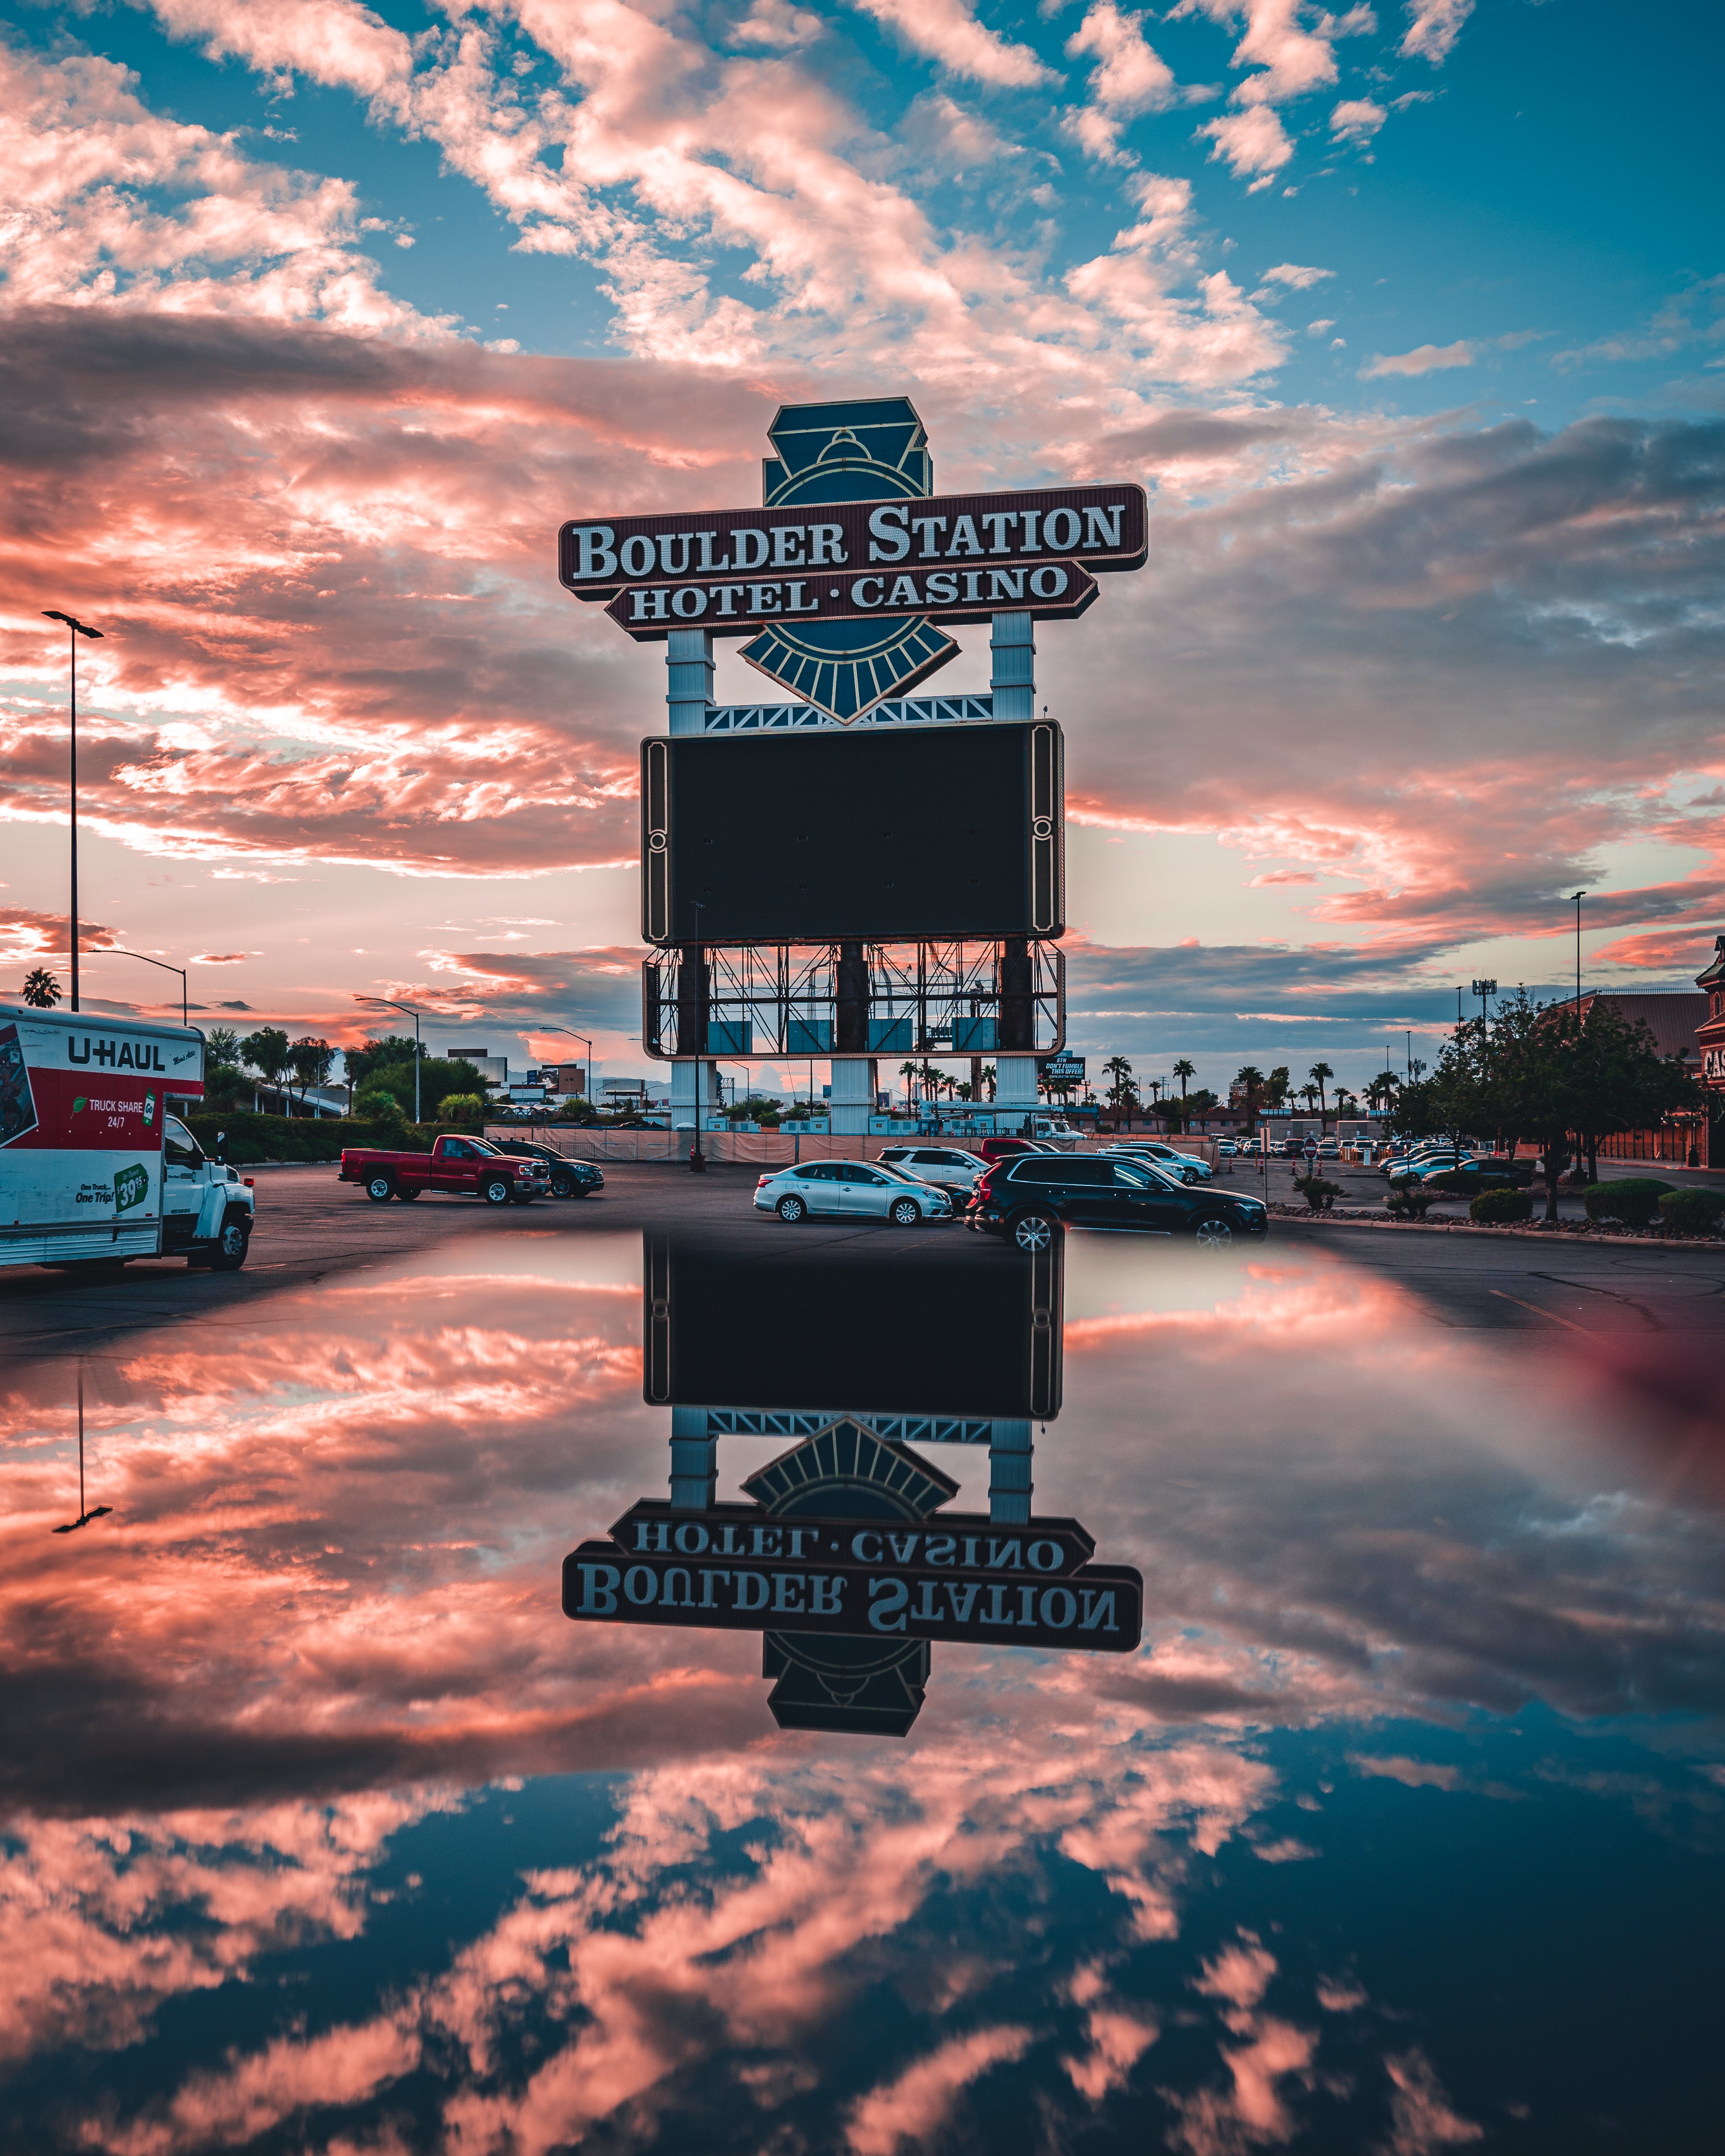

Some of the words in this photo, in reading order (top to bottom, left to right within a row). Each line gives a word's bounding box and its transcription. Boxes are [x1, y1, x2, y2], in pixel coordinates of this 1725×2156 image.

[573, 523, 849, 580] BOULDER
[868, 505, 1126, 562] STATION
[629, 582, 819, 621] HOTEL
[851, 566, 1069, 607] CASINO
[68, 1036, 165, 1072] U-HAUL
[90, 1100, 116, 1111] TRUCK
[118, 1101, 143, 1113] SHARE
[108, 1117, 124, 1128] 24/7
[76, 1193, 93, 1203] One
[95, 1192, 115, 1204] Trip!
